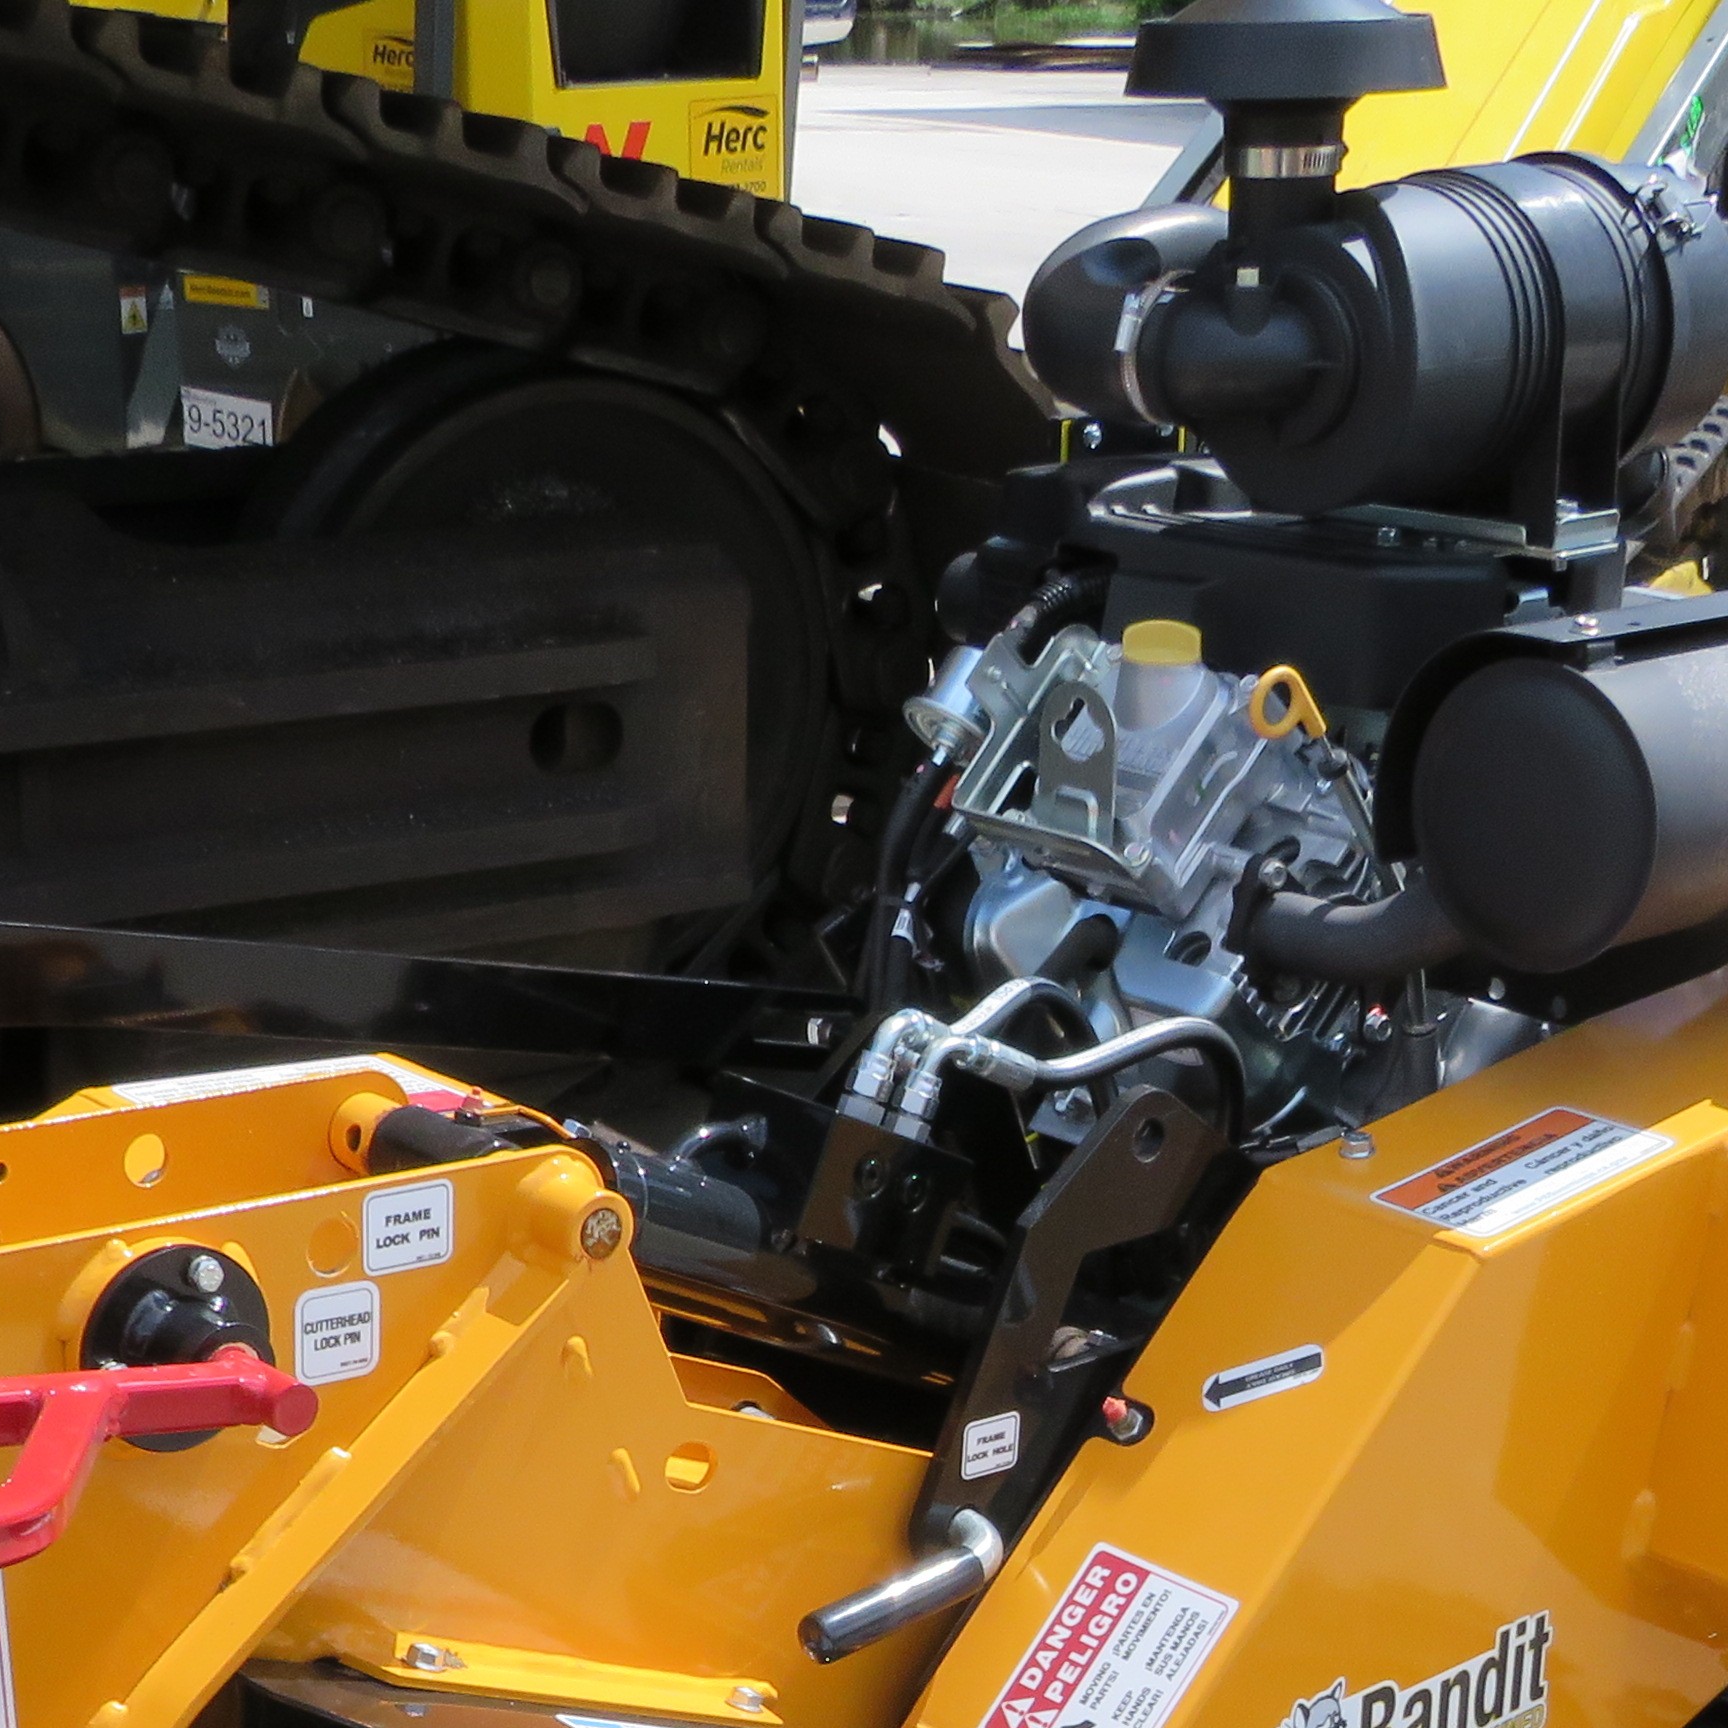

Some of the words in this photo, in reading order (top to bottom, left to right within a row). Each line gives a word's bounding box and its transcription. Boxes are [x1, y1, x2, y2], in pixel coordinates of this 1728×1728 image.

[703, 121, 767, 156] Herc
[1421, 1190, 1468, 1216] Cancer
[1471, 1178, 1497, 1193] and
[1439, 1179, 1527, 1222] Reproductive
[385, 1208, 431, 1227] FRAME
[376, 1233, 410, 1249] LOCK
[419, 1227, 440, 1241] PIN
[304, 1311, 371, 1335] CUTTERHEAD
[314, 1334, 342, 1351] LOCK
[344, 1332, 361, 1345] PIN
[967, 1450, 989, 1462] LOCK
[976, 1431, 1006, 1446] FRAME
[1018, 1565, 1111, 1691] DANGER
[1043, 1571, 1138, 1704] PELIGRO
[1112, 1609, 1145, 1657] ¡PARTES
[1141, 1592, 1157, 1611] EN
[1121, 1588, 1172, 1662] MOVIMIENTO!
[1145, 1605, 1190, 1672] ¡MANTENGA
[1153, 1649, 1174, 1677] SUS
[1171, 1610, 1201, 1652] MANOS
[1165, 1619, 1209, 1682] ALEJADAS!
[1078, 1661, 1112, 1705] MOVING
[1089, 1671, 1120, 1711] PARTS!
[1112, 1690, 1135, 1721] KEEP
[1123, 1686, 1152, 1727] HANDS
